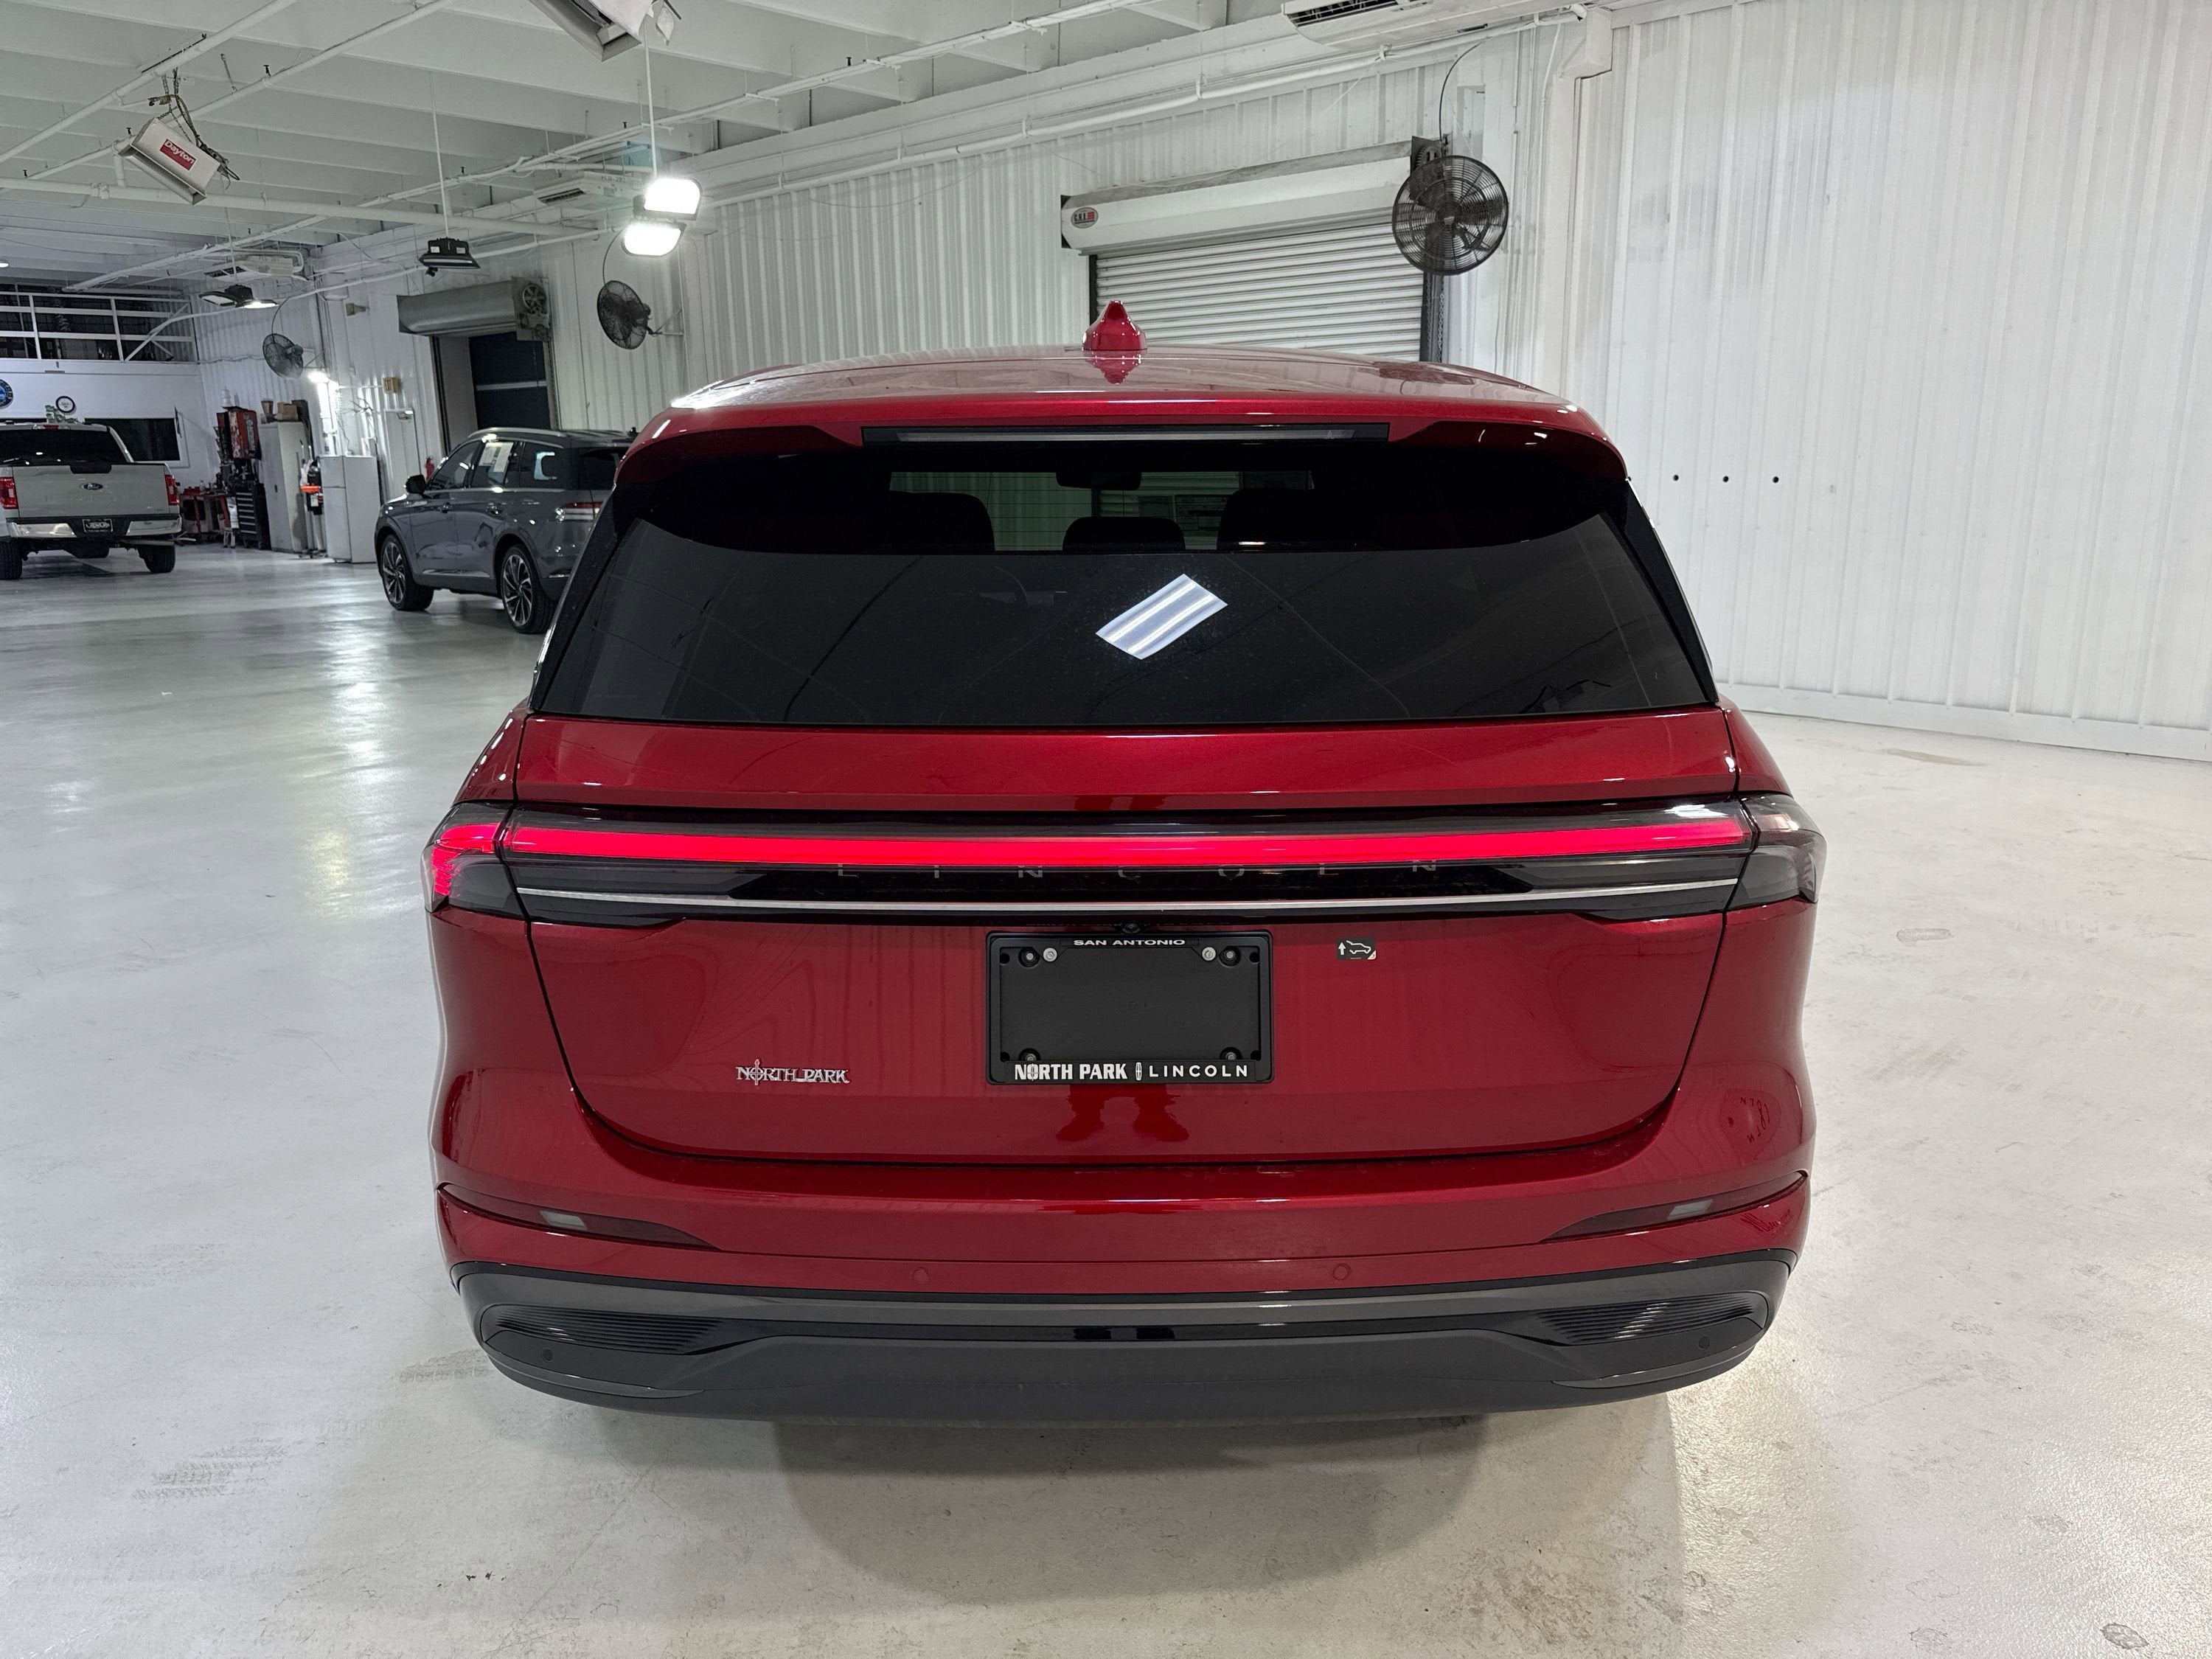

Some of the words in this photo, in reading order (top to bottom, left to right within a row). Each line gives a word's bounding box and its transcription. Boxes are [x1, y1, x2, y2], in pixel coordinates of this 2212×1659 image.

[164, 140, 195, 164] Dayton
[838, 860, 1436, 878] LINCOLN
[736, 1060, 800, 1085] NORTH
[801, 1068, 850, 1084] PARK
[1015, 1062, 1073, 1081] NORTH
[1079, 1062, 1127, 1080] PARK
[1150, 1064, 1248, 1077] LINCOLN
